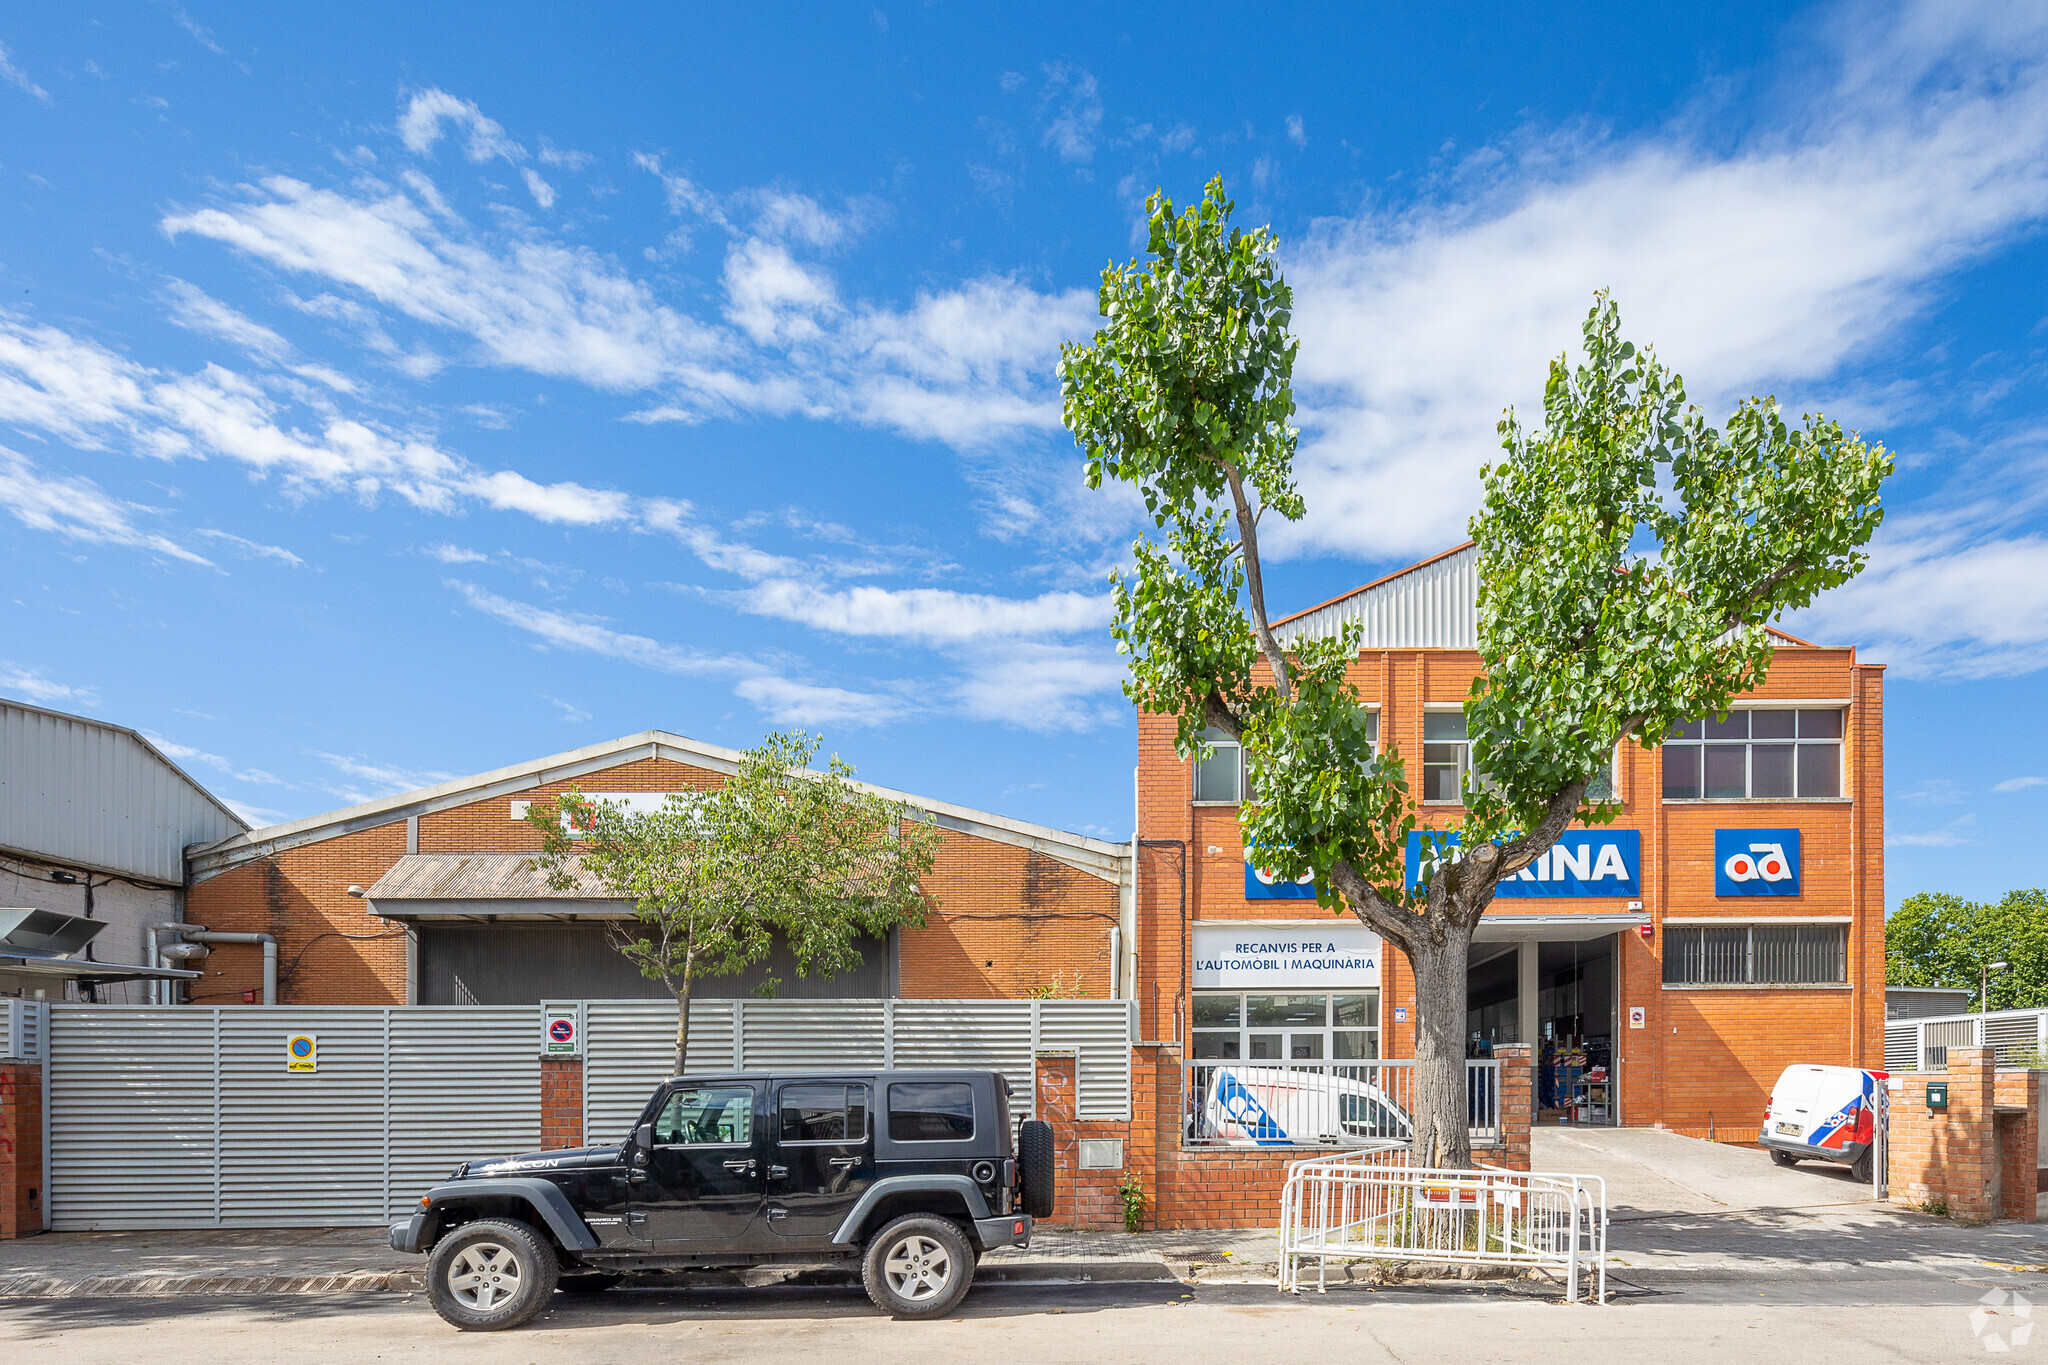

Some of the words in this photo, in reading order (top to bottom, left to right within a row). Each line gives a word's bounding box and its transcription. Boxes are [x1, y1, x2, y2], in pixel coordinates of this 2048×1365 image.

[1417, 844, 1630, 882] MINA
[1235, 943, 1298, 954] RECANVIS
[1301, 942, 1322, 953] PER
[1326, 942, 1336, 953] A
[1196, 957, 1280, 971] L'AUTOMÒBIL
[1284, 960, 1287, 970] I
[1291, 956, 1375, 970] MAQUINÀRIA
